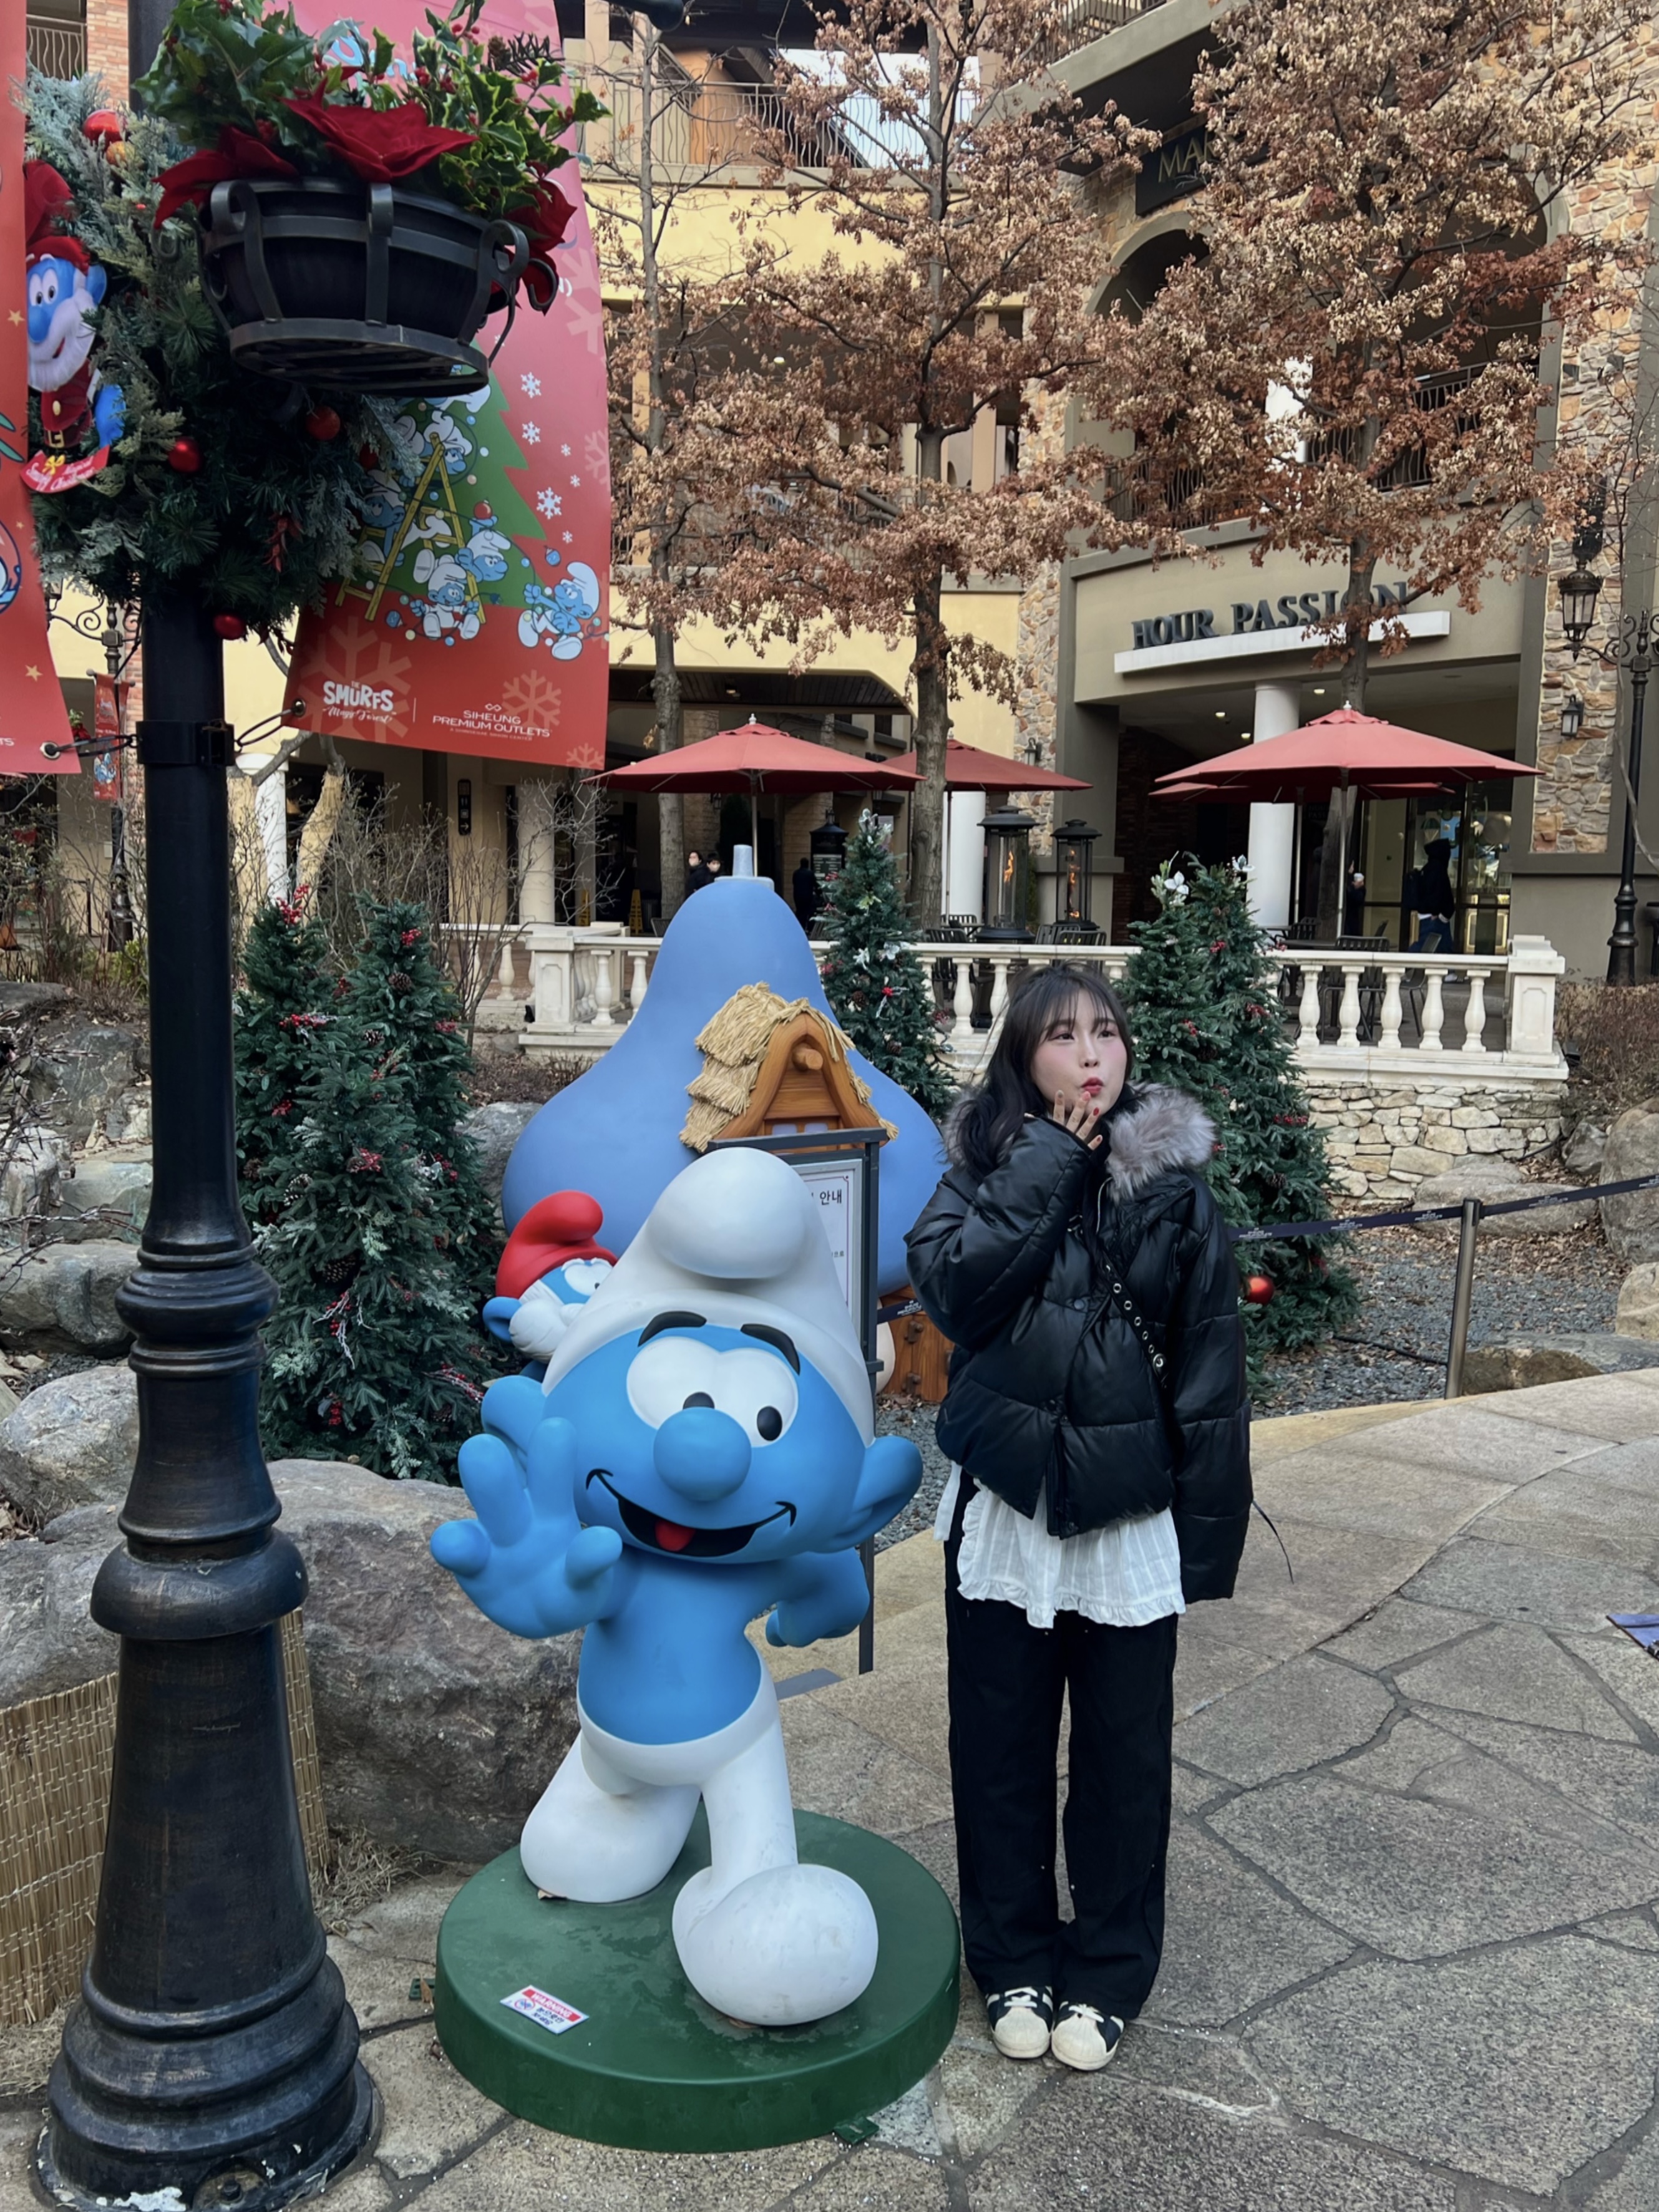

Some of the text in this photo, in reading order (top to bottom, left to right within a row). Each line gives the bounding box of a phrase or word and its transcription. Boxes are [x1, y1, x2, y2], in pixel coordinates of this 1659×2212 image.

[1131, 609, 1220, 651] HOUR
[323, 681, 394, 712] SMURFS
[463, 709, 521, 725] SIHEUNG
[432, 716, 550, 738] PREMIUM OUTLETS
[819, 1189, 842, 1205] 안내
[832, 1250, 845, 1258] 으로
